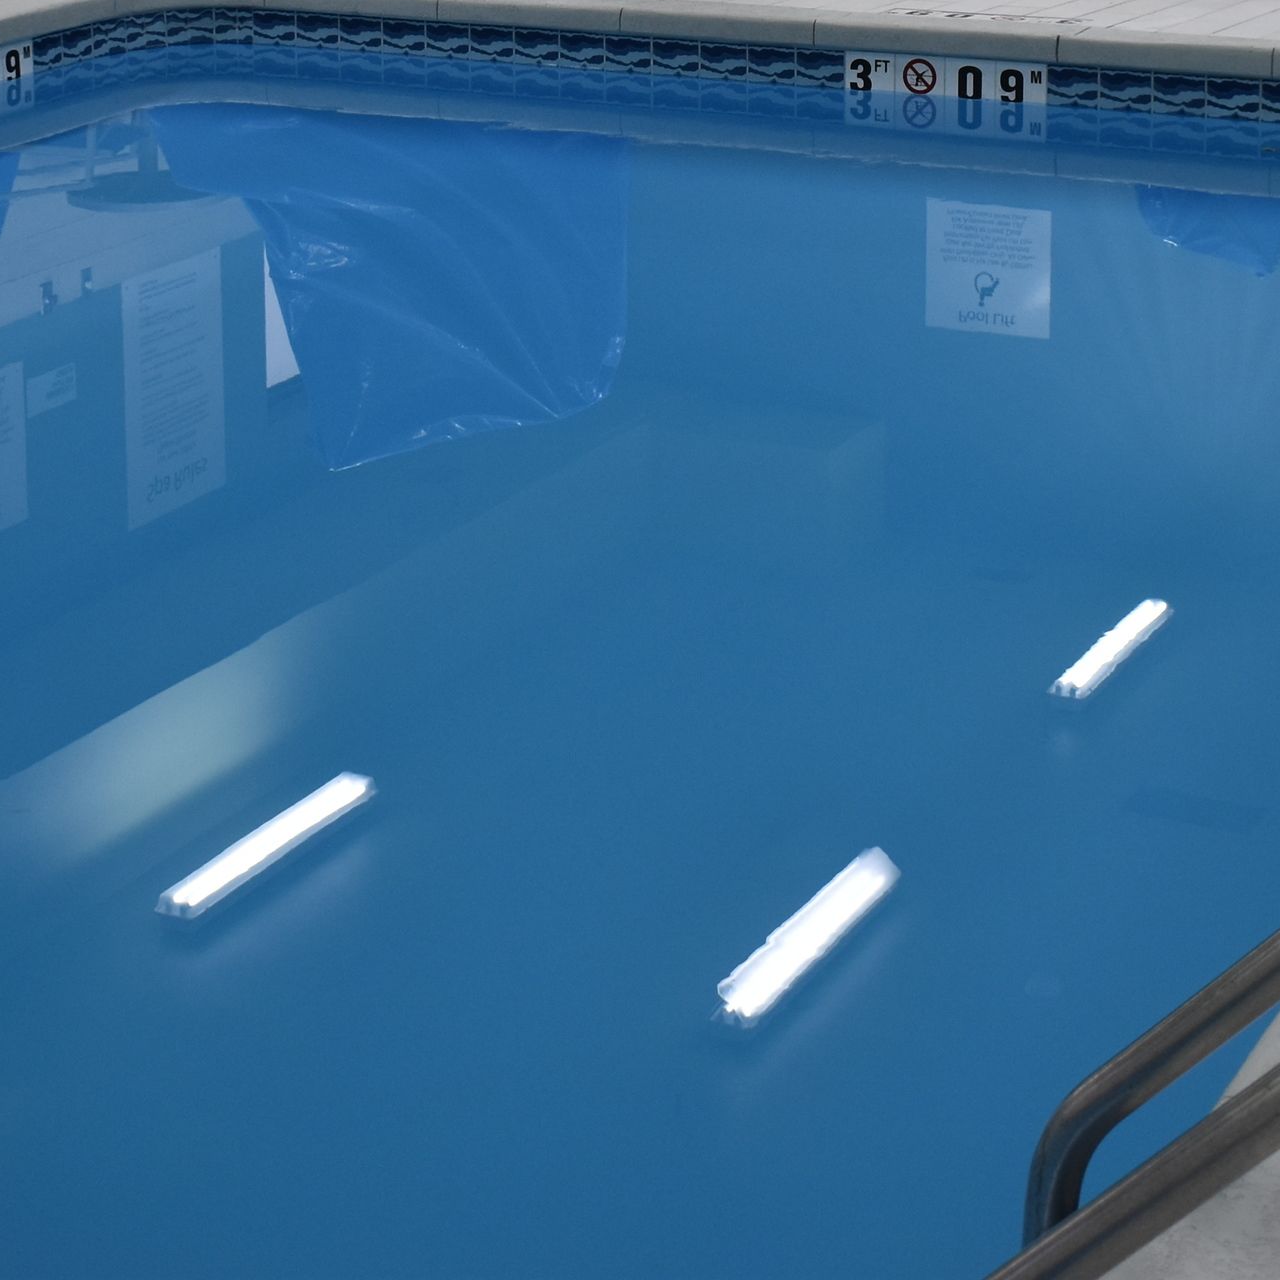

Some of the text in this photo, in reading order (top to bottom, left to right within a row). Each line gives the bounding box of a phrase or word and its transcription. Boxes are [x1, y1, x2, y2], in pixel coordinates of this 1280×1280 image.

[23, 46, 31, 59] M
[849, 58, 872, 91] 3
[874, 59, 890, 73] FT
[1031, 70, 1042, 84] M
